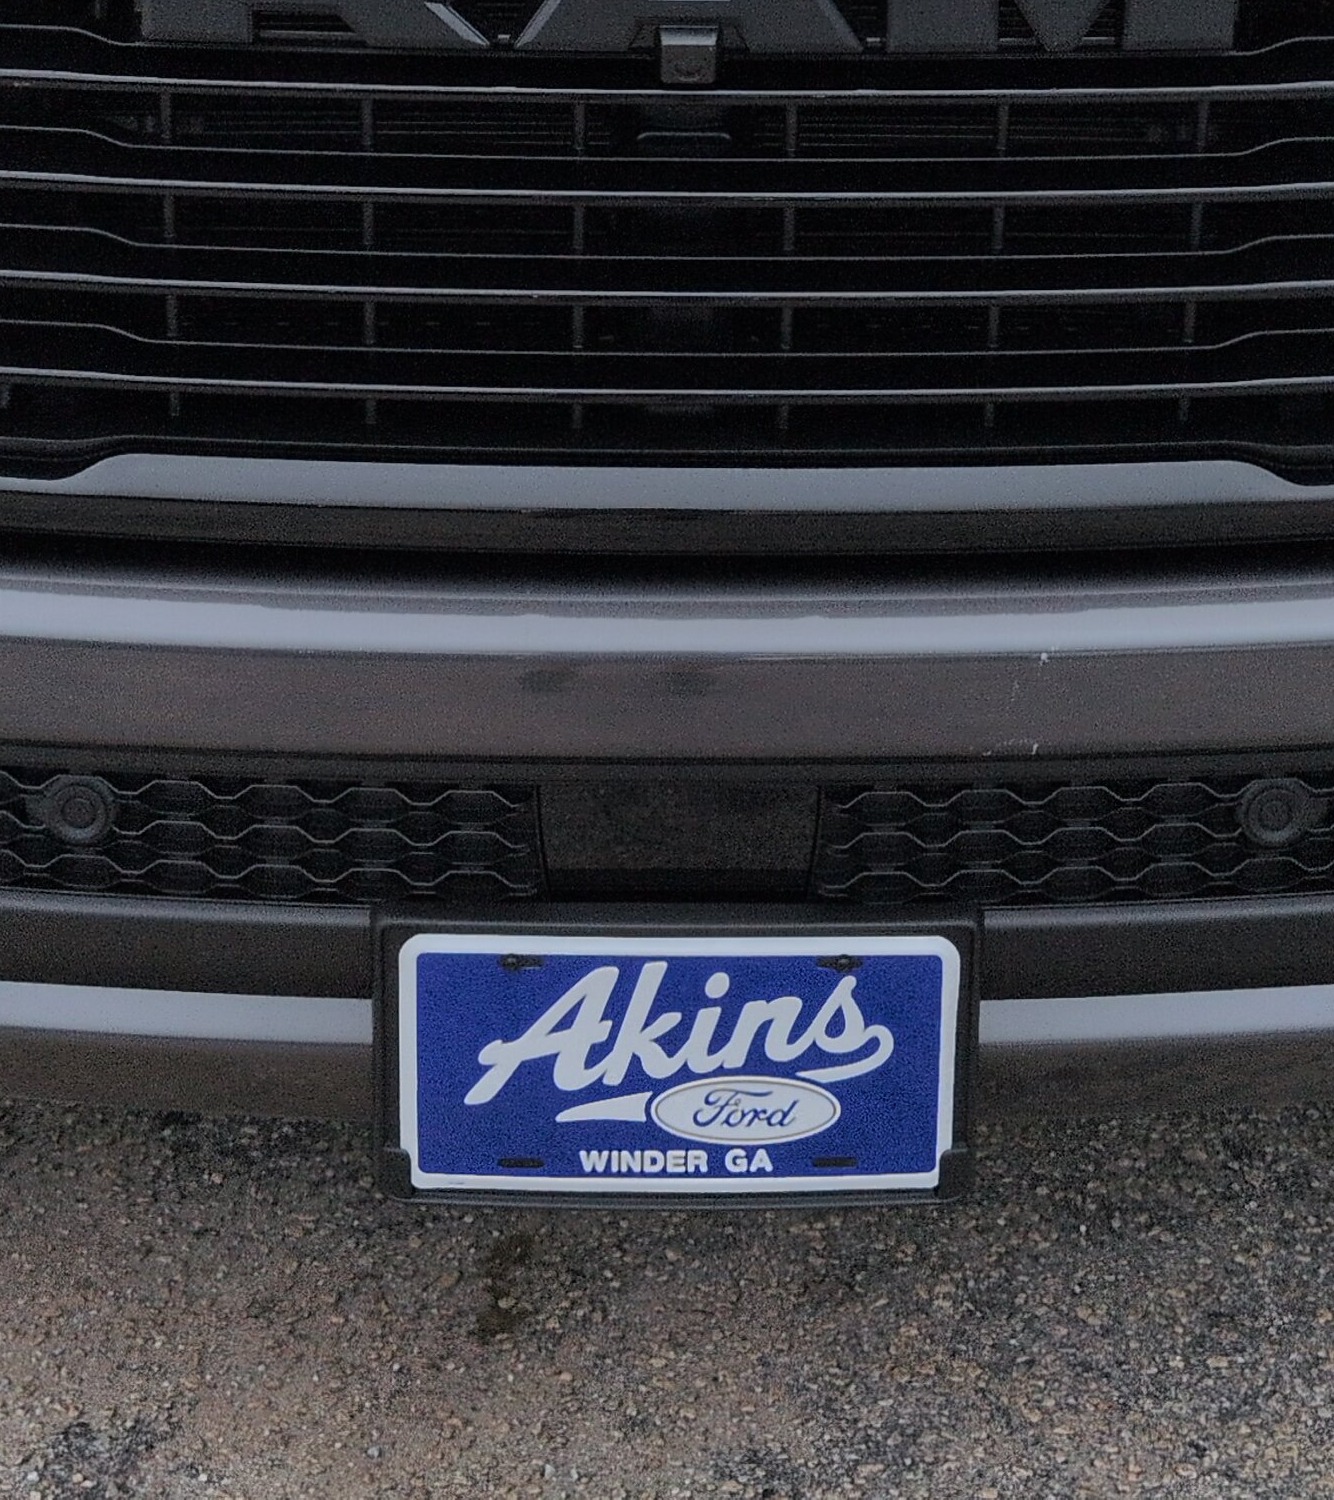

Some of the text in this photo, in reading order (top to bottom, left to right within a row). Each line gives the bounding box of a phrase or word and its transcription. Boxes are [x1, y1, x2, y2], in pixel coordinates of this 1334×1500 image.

[464, 960, 894, 1105] Akins
[691, 1089, 799, 1130] Ford
[579, 1148, 774, 1174] WINDER GA
